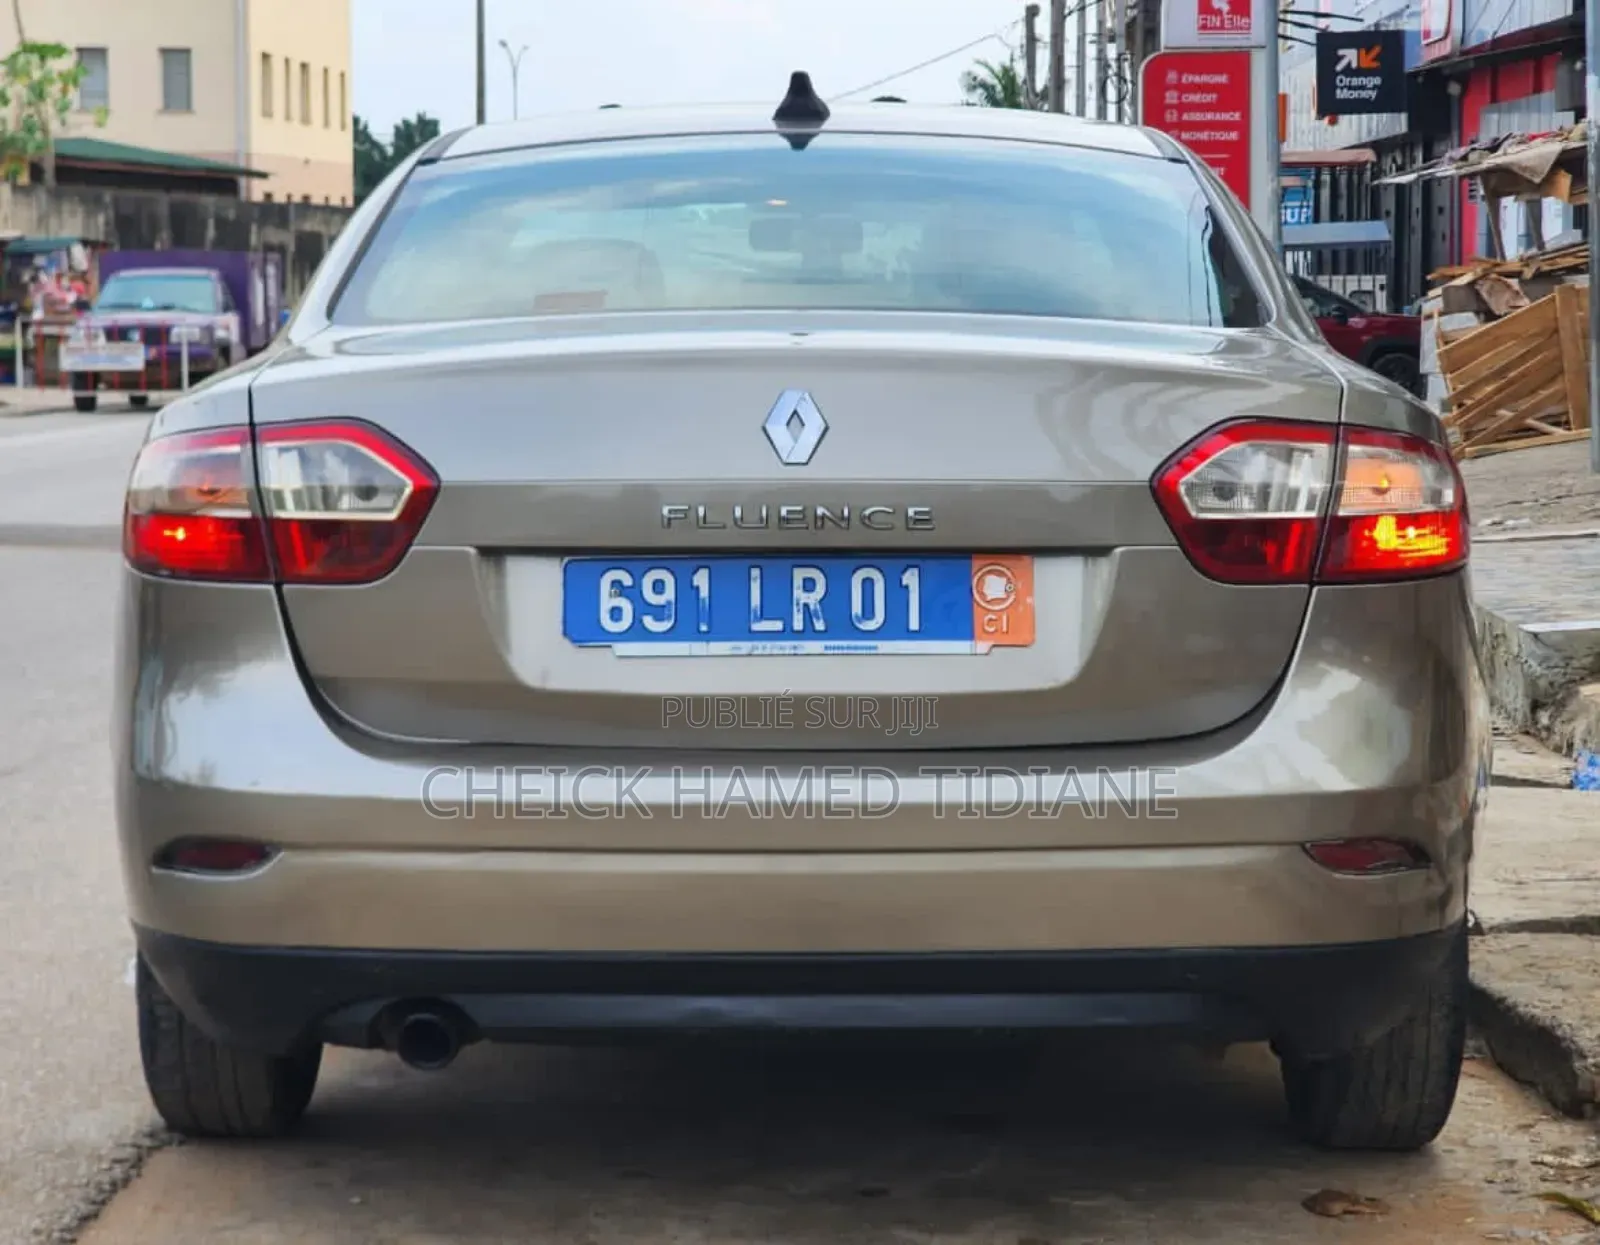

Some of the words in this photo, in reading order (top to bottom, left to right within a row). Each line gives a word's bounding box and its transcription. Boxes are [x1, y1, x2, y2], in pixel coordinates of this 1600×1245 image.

[1199, 14, 1221, 28] FIN
[1223, 14, 1250, 28] Elle
[1335, 75, 1382, 88] Orange
[1335, 88, 1377, 101] Money
[1181, 111, 1242, 121] ASSURANCE
[661, 504, 936, 531] FLUENCE
[598, 565, 711, 634] 691
[749, 564, 828, 632] LR
[850, 564, 922, 632] 01
[983, 611, 1008, 634] CI
